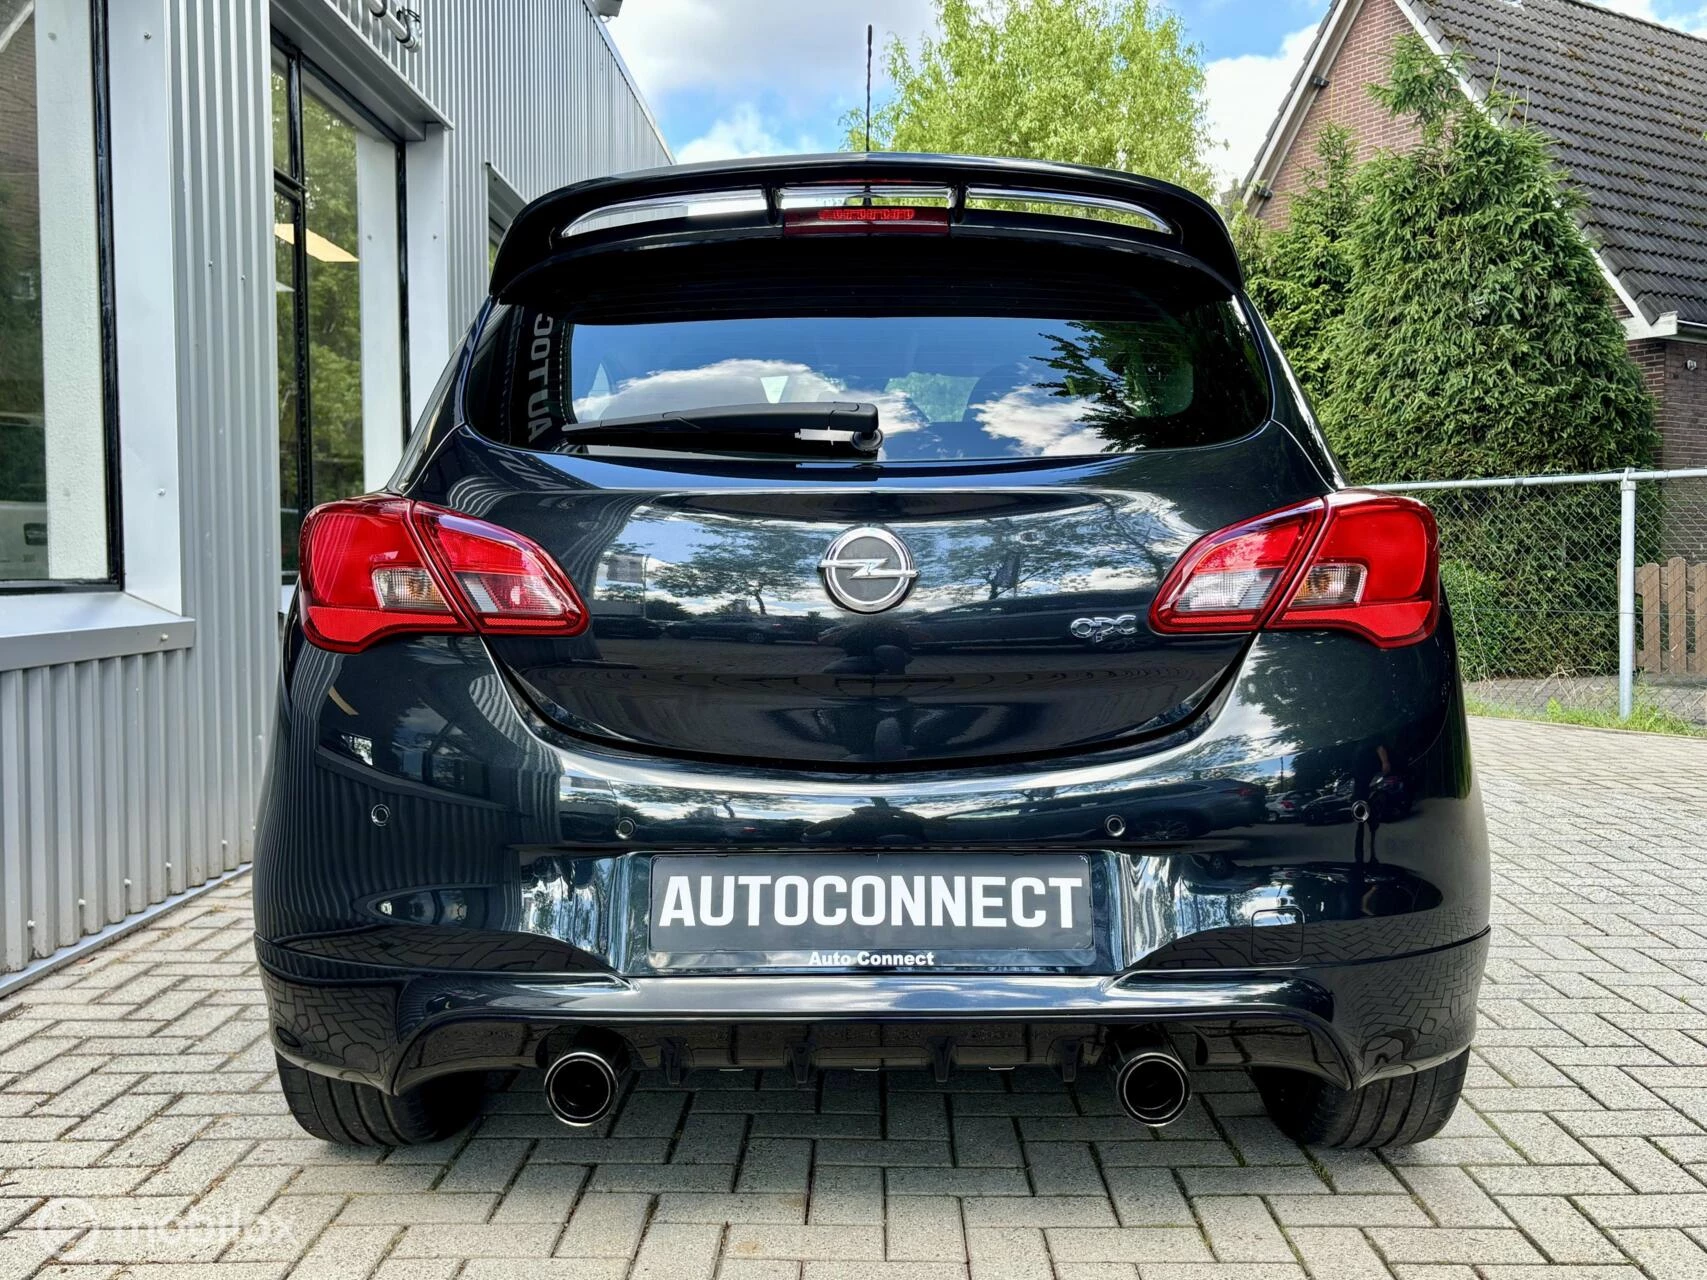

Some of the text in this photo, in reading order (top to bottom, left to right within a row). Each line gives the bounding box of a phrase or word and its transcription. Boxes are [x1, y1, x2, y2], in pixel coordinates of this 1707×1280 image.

[658, 875, 1082, 929] AUTOCONNECT
[809, 951, 935, 966] Auto Connect
